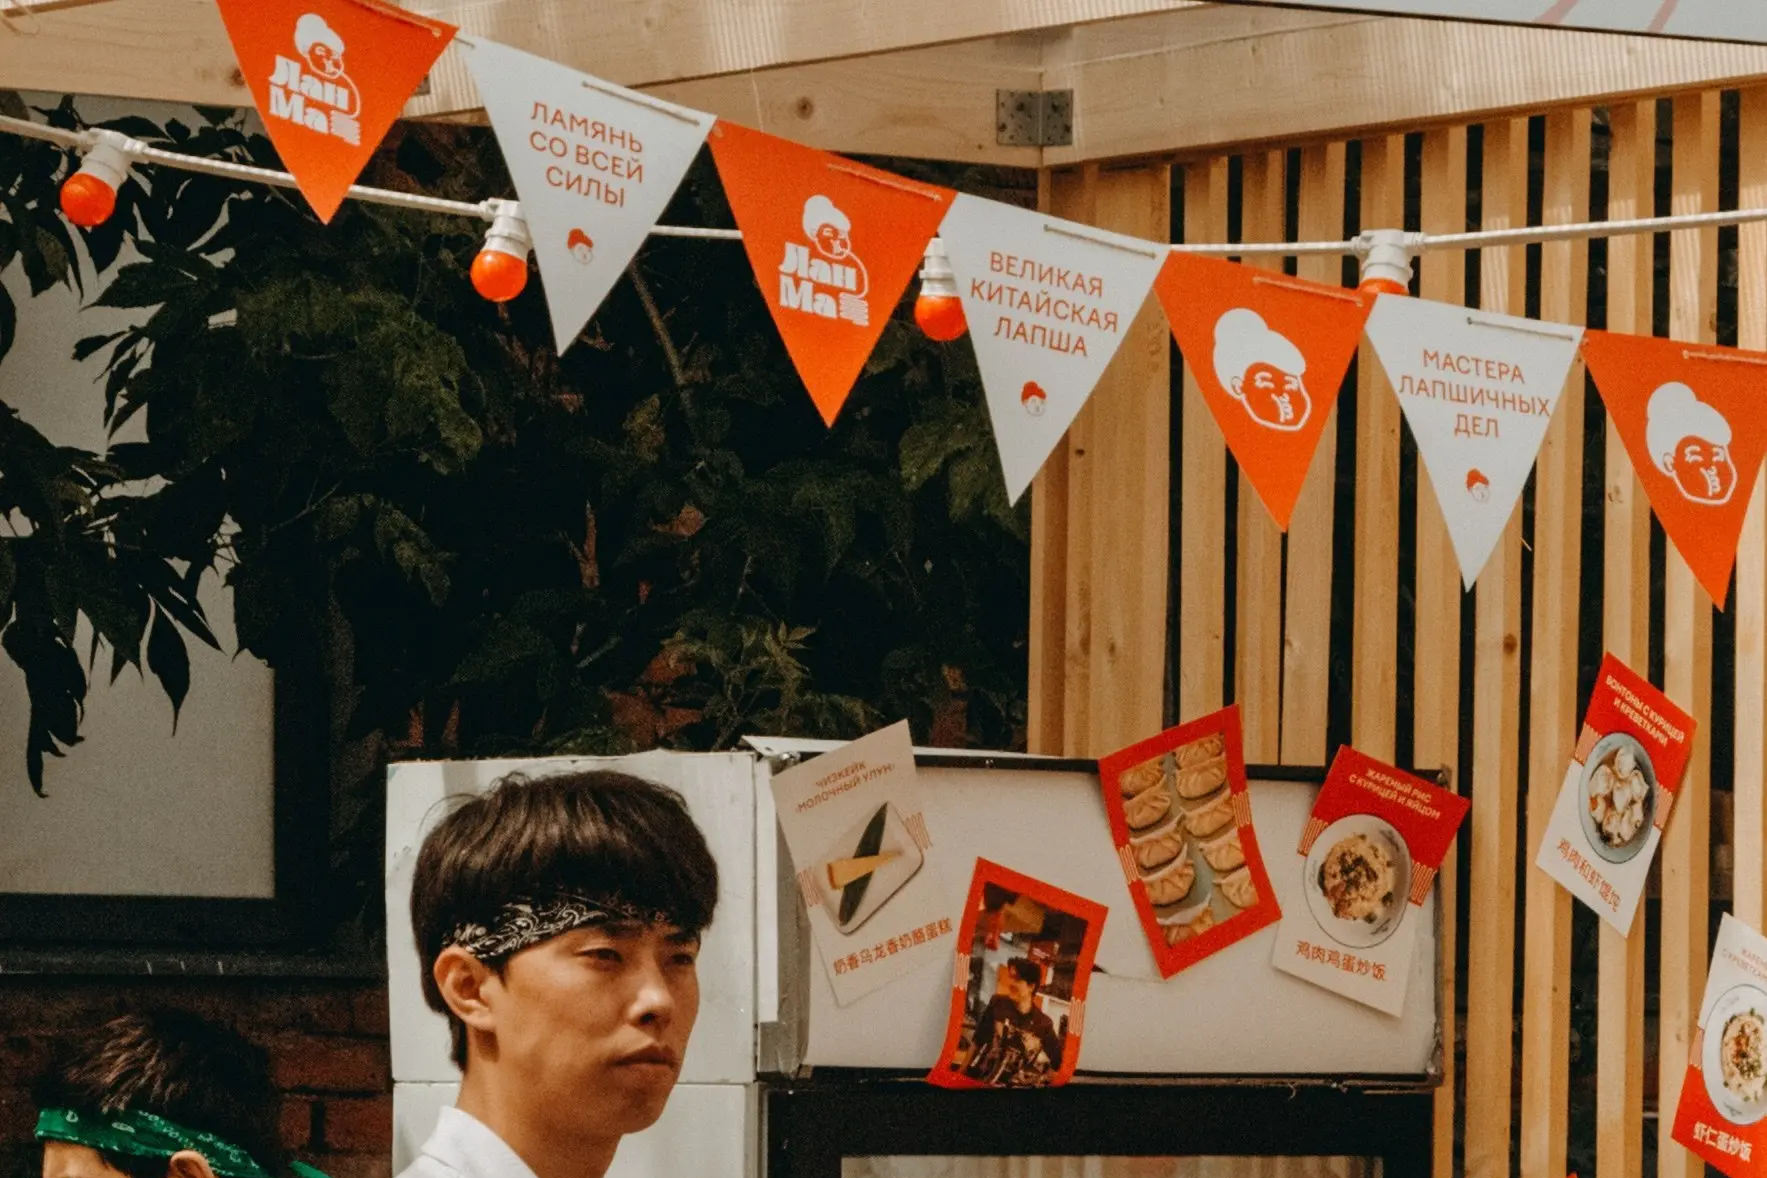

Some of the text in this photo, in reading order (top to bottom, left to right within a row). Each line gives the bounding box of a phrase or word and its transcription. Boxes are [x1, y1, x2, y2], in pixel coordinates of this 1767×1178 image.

[530, 102, 644, 154] ЛАМЯНЬ
[530, 131, 644, 184] СО ВСЕЙ
[546, 166, 625, 208] СИЛЫ
[990, 251, 1104, 298] ВЕЛИКАЯ
[970, 279, 1118, 333] КИТАЙСКАЯ
[993, 316, 1087, 357] ЛАПША
[1422, 349, 1525, 384] МАСТЕРА
[1399, 375, 1551, 417] ЛАПШИЧНЫХ
[1454, 414, 1499, 438] ДЕЛ
[1605, 674, 1644, 711] ВОНТОНЫ
[1648, 709, 1685, 744] КУРИЦЕЙ
[1613, 696, 1668, 747] И КРЕВЕТКАМИ
[816, 761, 866, 788] ЧИЗКЕЙК
[1366, 768, 1432, 803] ЖАРЕНЫЙ РИС
[1349, 774, 1441, 820] С КУРИЦЕЙ И ЯЙЦОМ
